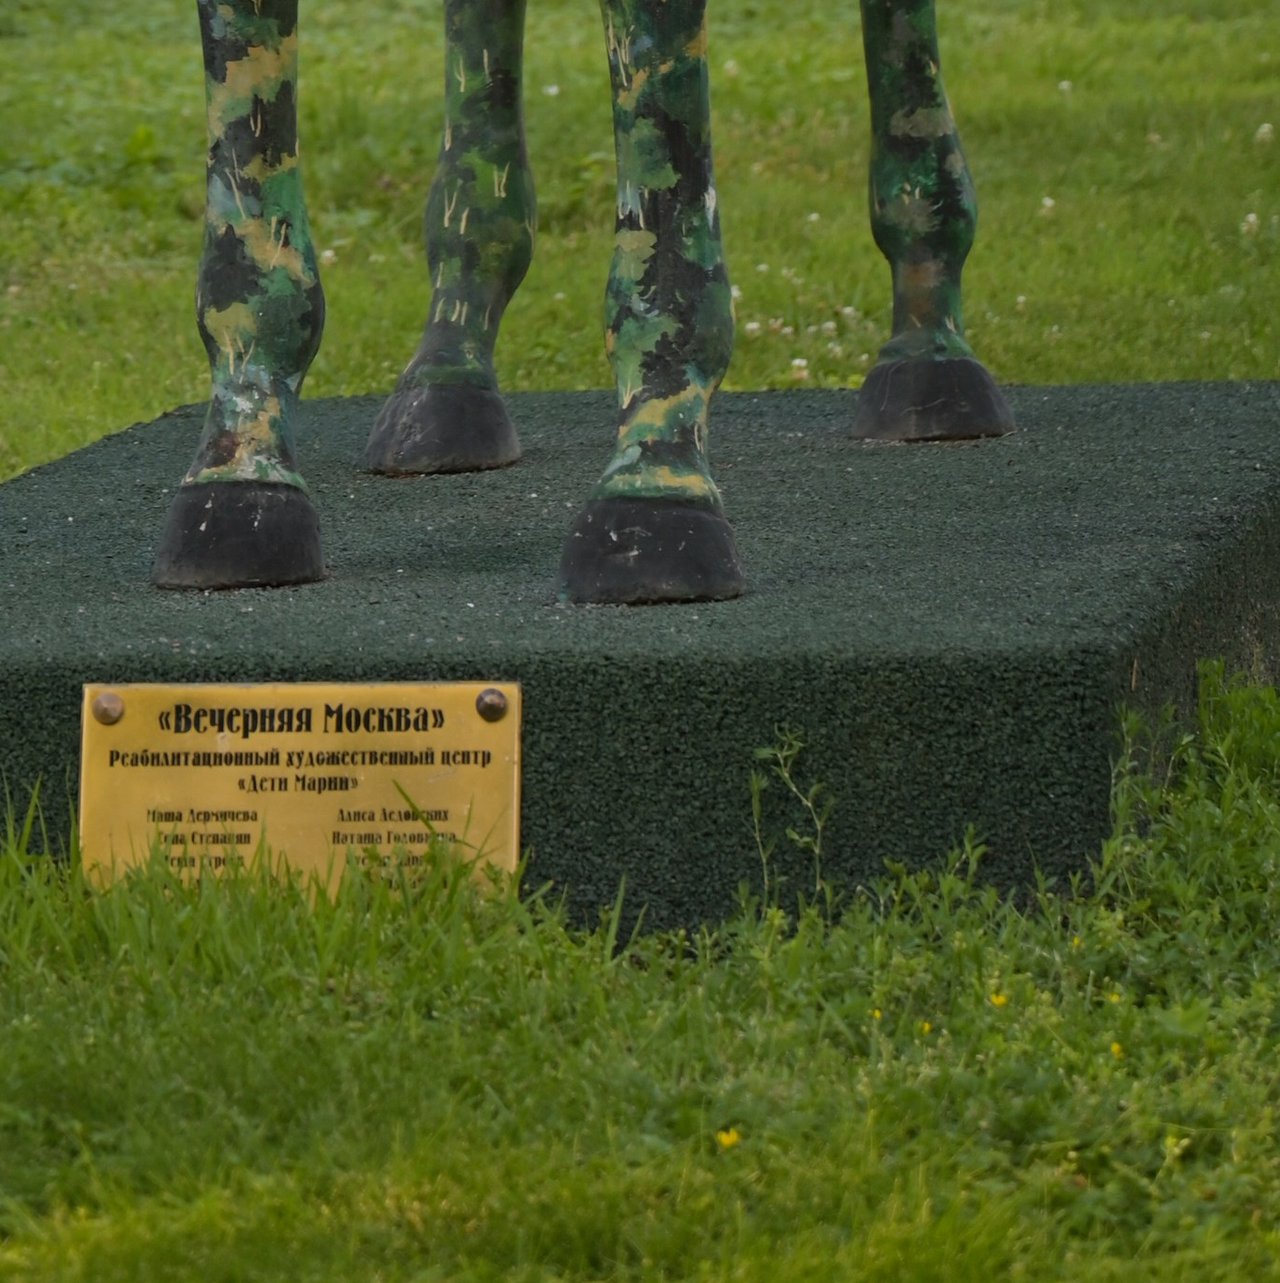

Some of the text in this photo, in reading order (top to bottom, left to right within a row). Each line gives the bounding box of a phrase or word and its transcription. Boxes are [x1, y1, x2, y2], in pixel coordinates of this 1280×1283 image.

[158, 703, 446, 738] «Вечерняя Москва»
[109, 747, 492, 769] Реабилитационный художественный центр
[238, 773, 359, 794] «Дети Марии»
[337, 808, 376, 823] Алиса
[332, 831, 383, 845] Наташа
